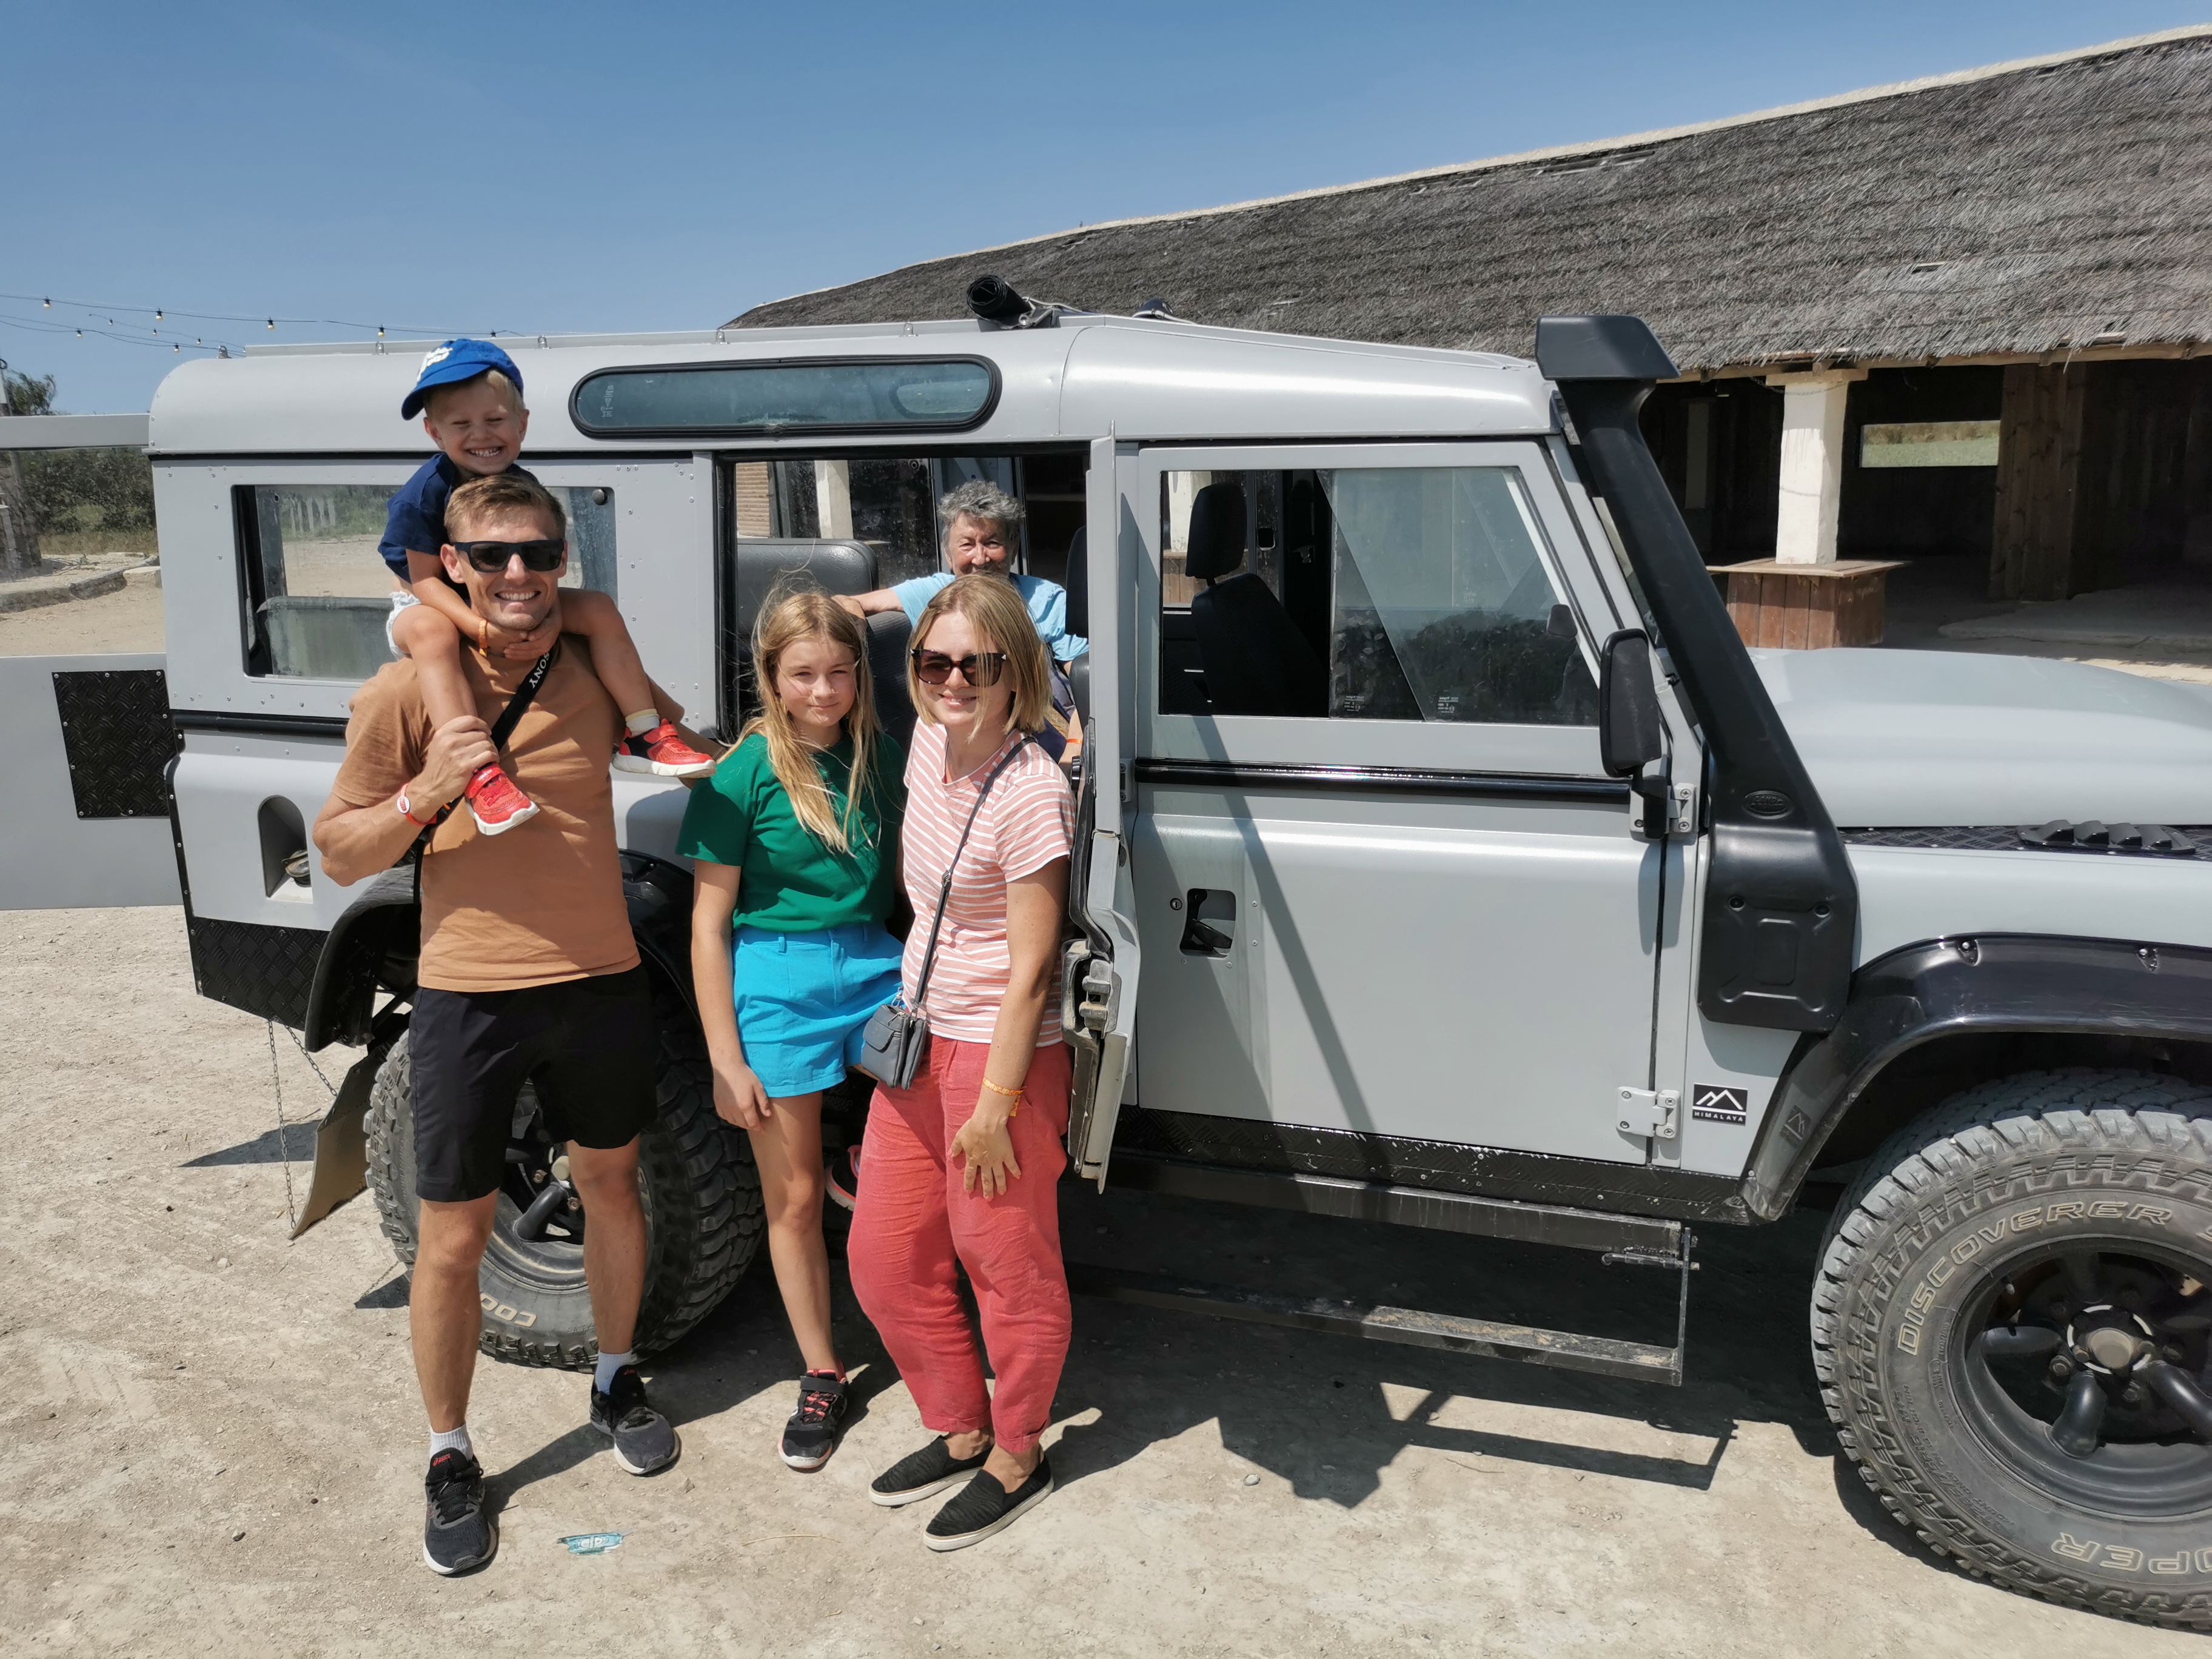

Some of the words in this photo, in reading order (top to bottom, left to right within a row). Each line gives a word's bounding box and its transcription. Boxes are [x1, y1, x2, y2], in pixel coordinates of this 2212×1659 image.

[529, 651, 549, 689] SONY
[1694, 1111, 1743, 1122] HIMALAYA
[1897, 1201, 2173, 1356] DISCOVERER
